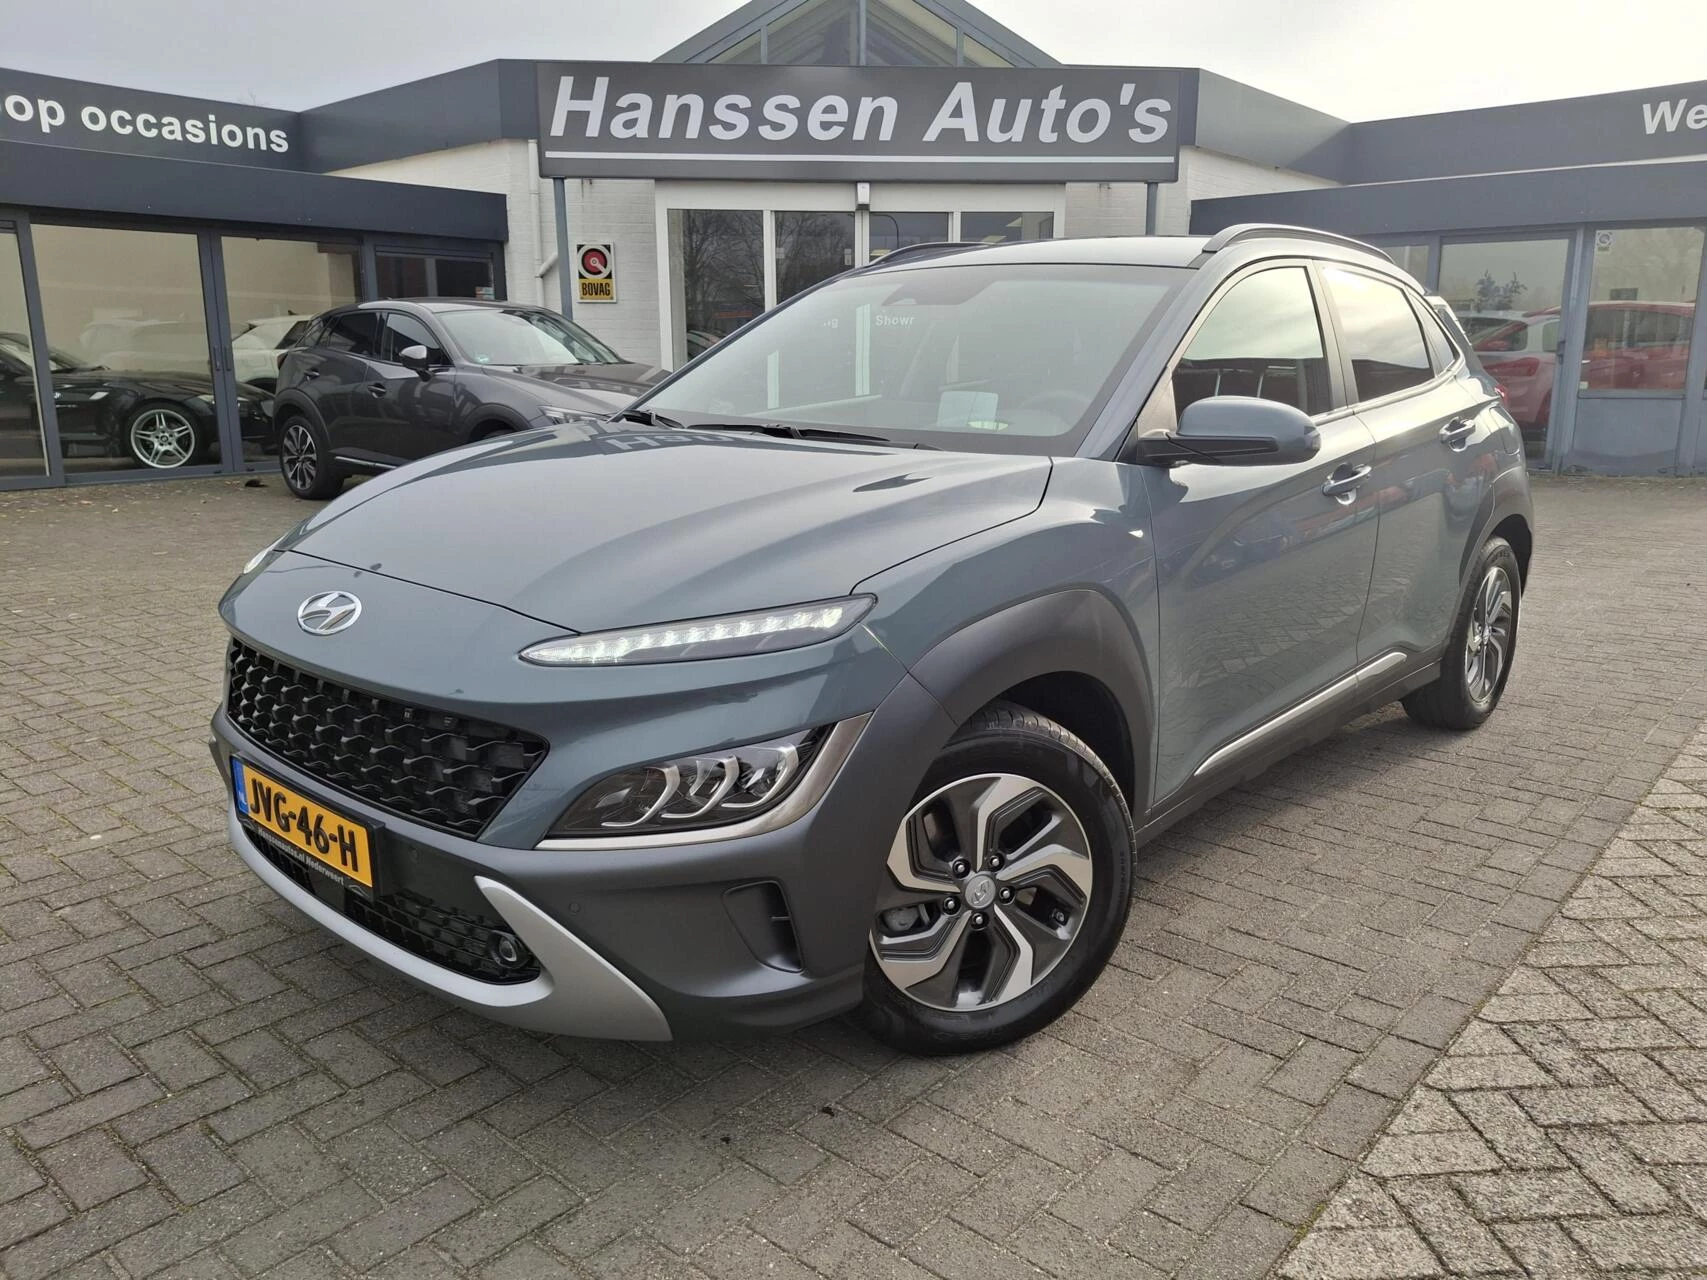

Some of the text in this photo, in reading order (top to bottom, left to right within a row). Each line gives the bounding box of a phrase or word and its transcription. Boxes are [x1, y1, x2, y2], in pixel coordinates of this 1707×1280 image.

[0, 94, 289, 153] op occasions
[549, 76, 1172, 144] Hanssen Auto's
[581, 282, 611, 297] BOVAG
[249, 777, 359, 873] JVG-46-H
